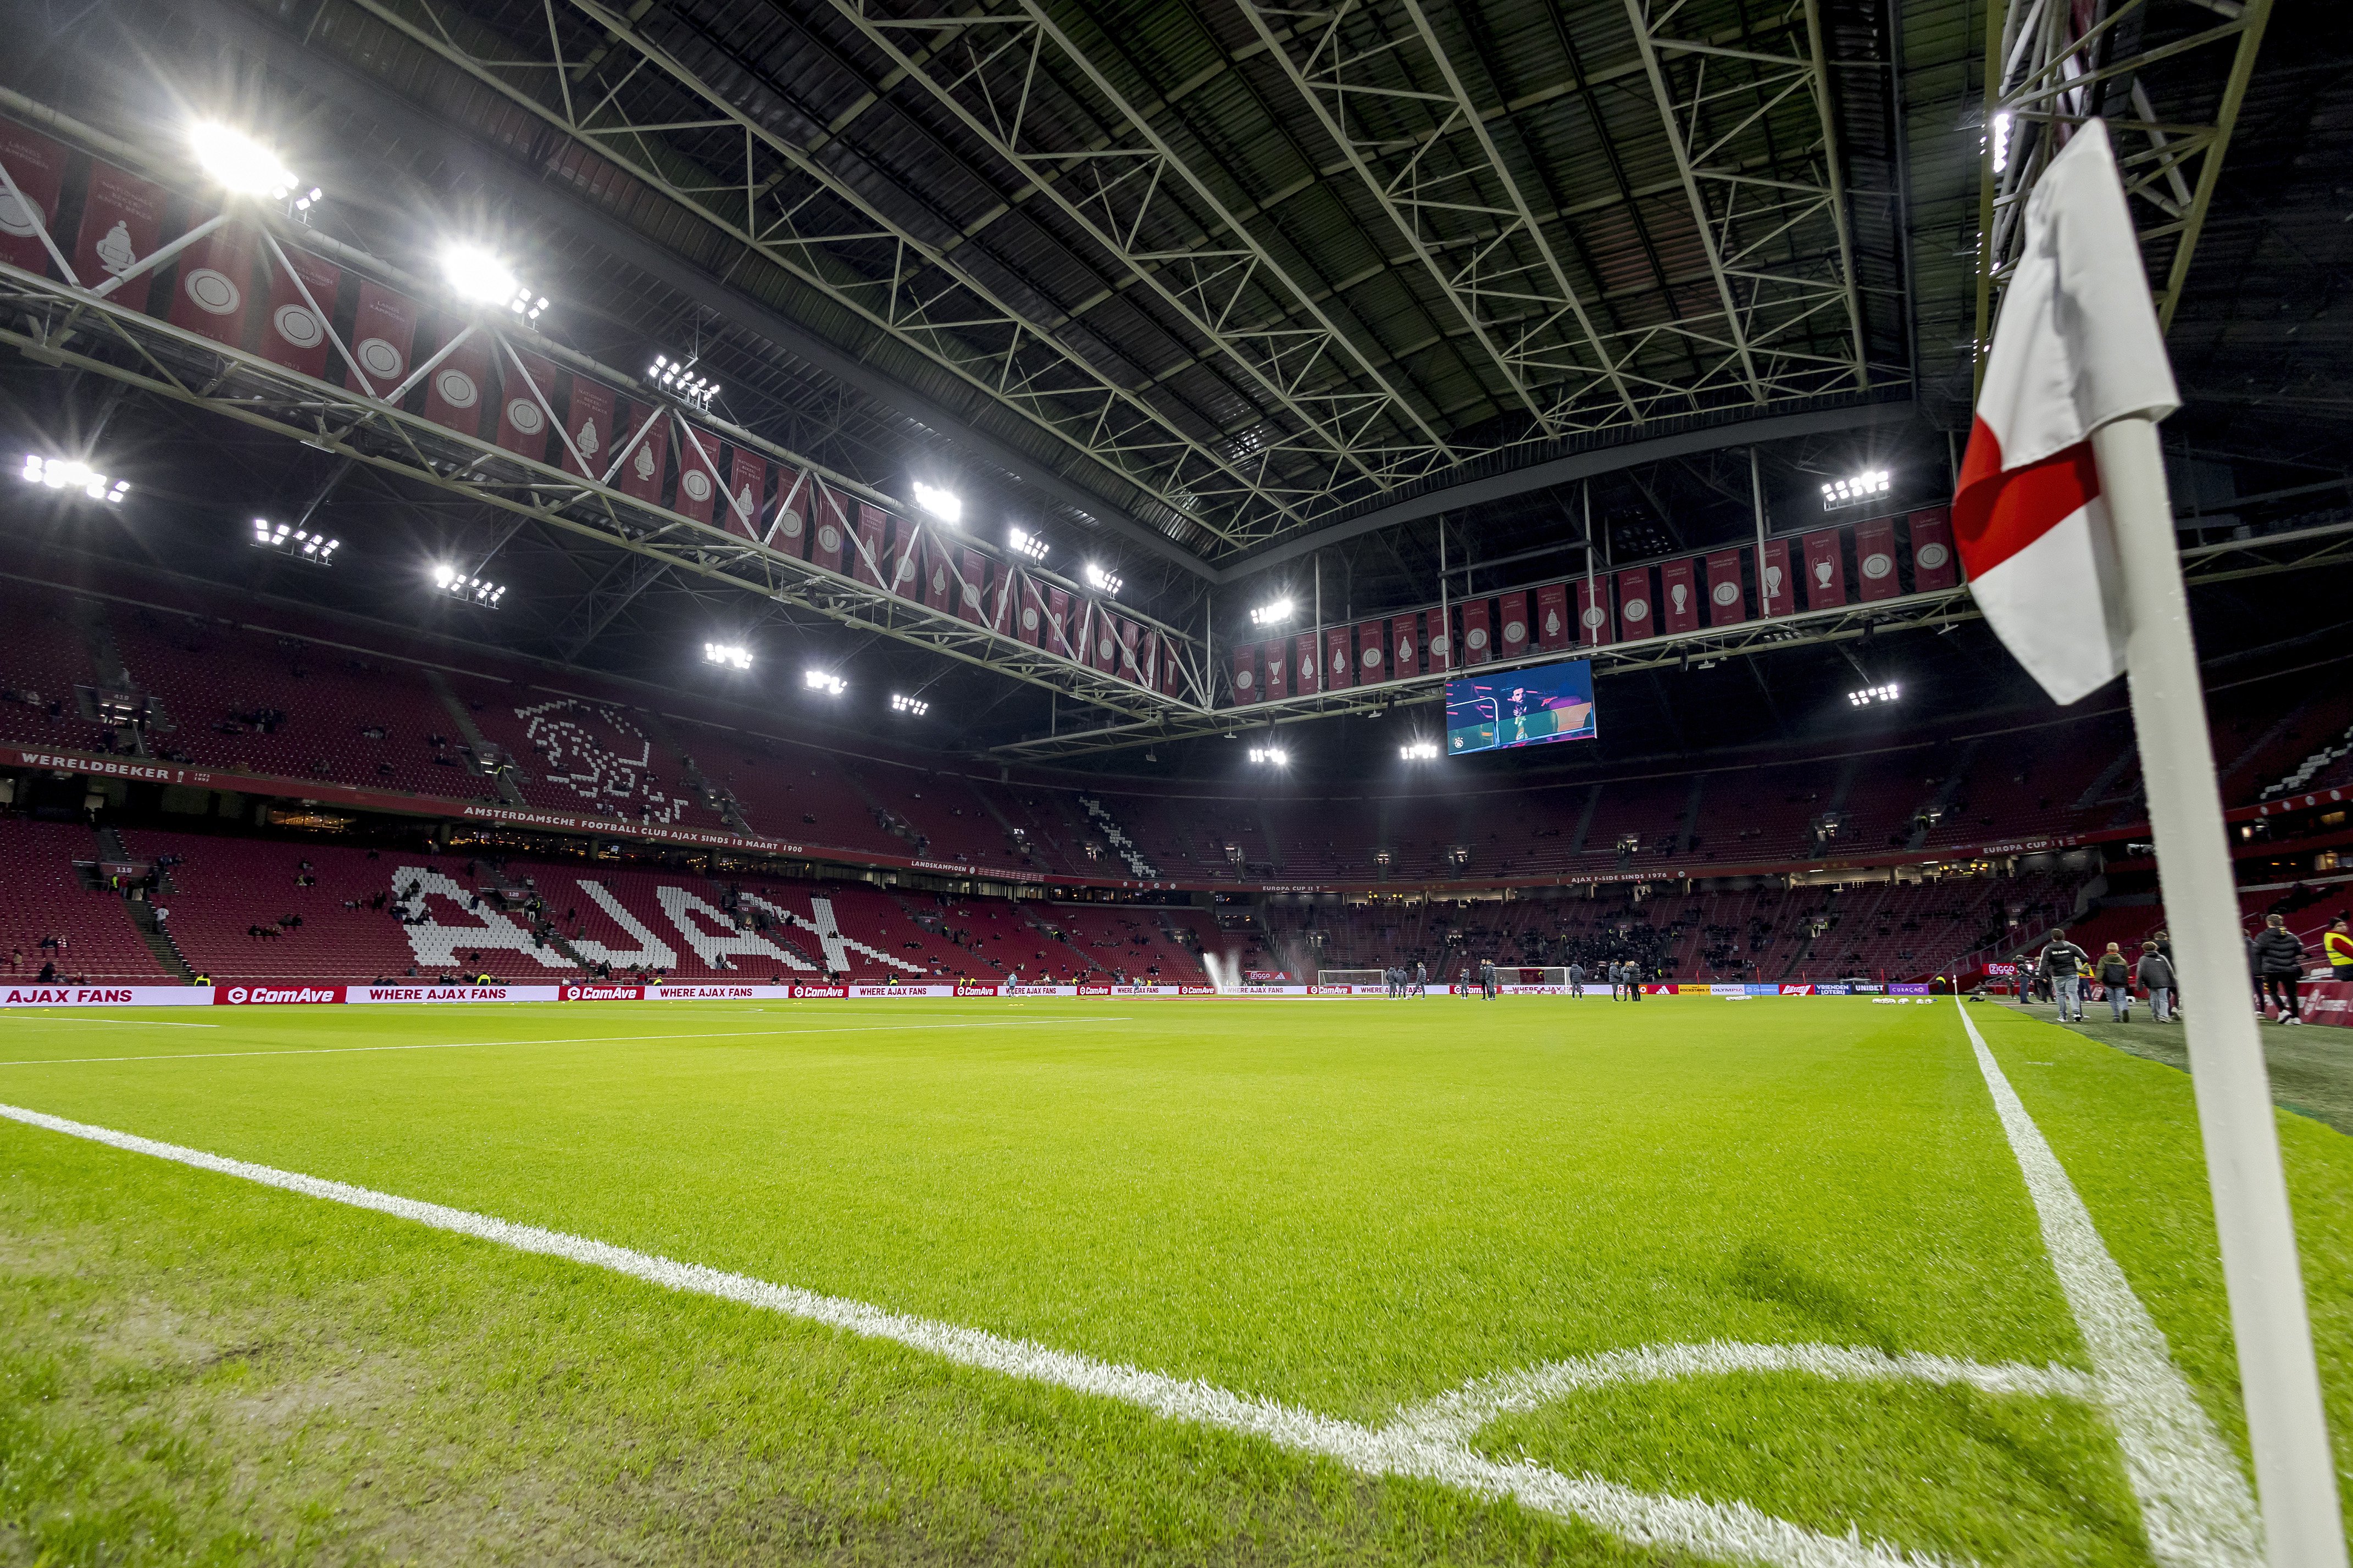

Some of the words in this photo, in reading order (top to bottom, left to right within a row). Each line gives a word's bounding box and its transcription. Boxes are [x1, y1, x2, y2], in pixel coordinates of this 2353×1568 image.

[21, 753, 169, 780] WERELDBEKER
[464, 806, 575, 827] AMSTERDAMSCHE
[581, 820, 637, 834] FOOTBALL
[641, 827, 668, 837] CLUB
[671, 831, 697, 841] AJAX
[701, 835, 729, 844] SINDS
[746, 840, 778, 850] MAART
[783, 844, 802, 853] 1900
[1983, 844, 2023, 854] EUROPA
[911, 860, 967, 872] LANDSKAMPIOEN
[392, 865, 928, 973] AJAX
[6, 989, 70, 1003] AJAX
[77, 989, 132, 1003] FANS
[251, 988, 334, 1003] ComAve
[370, 989, 423, 1000] WHERE
[426, 989, 467, 1000] AJAX
[471, 988, 507, 999] FANS
[582, 987, 637, 999] ComAve
[660, 988, 696, 997] WHERE
[698, 988, 725, 997] AJAX
[729, 988, 753, 997] FANS
[804, 987, 843, 998] ComAve
[859, 987, 886, 996] WHERE
[887, 987, 907, 996] AJAX
[964, 986, 994, 996] ComAve
[1085, 986, 1108, 995] ComAve
[1319, 986, 1348, 994] ComAve
